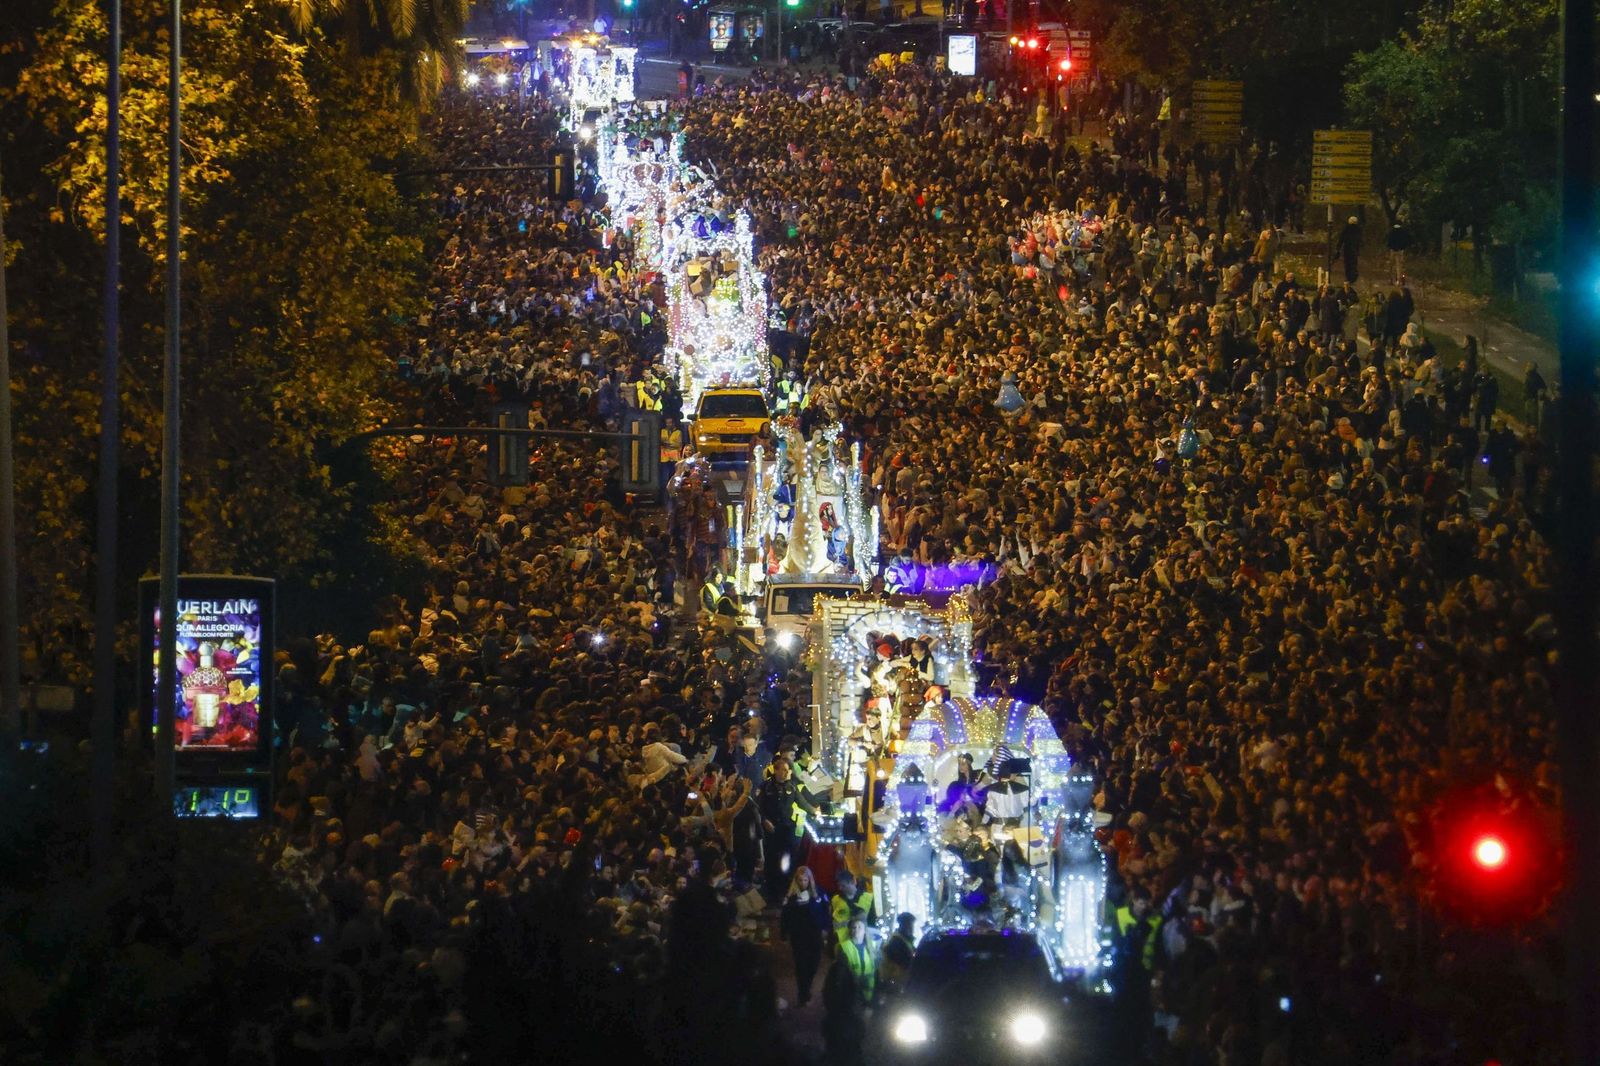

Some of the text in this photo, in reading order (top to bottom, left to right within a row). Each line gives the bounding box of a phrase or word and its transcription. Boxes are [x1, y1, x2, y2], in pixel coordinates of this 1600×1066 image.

[176, 601, 252, 614] UERLAIN
[175, 623, 244, 632] QUA ALLEGORIA
